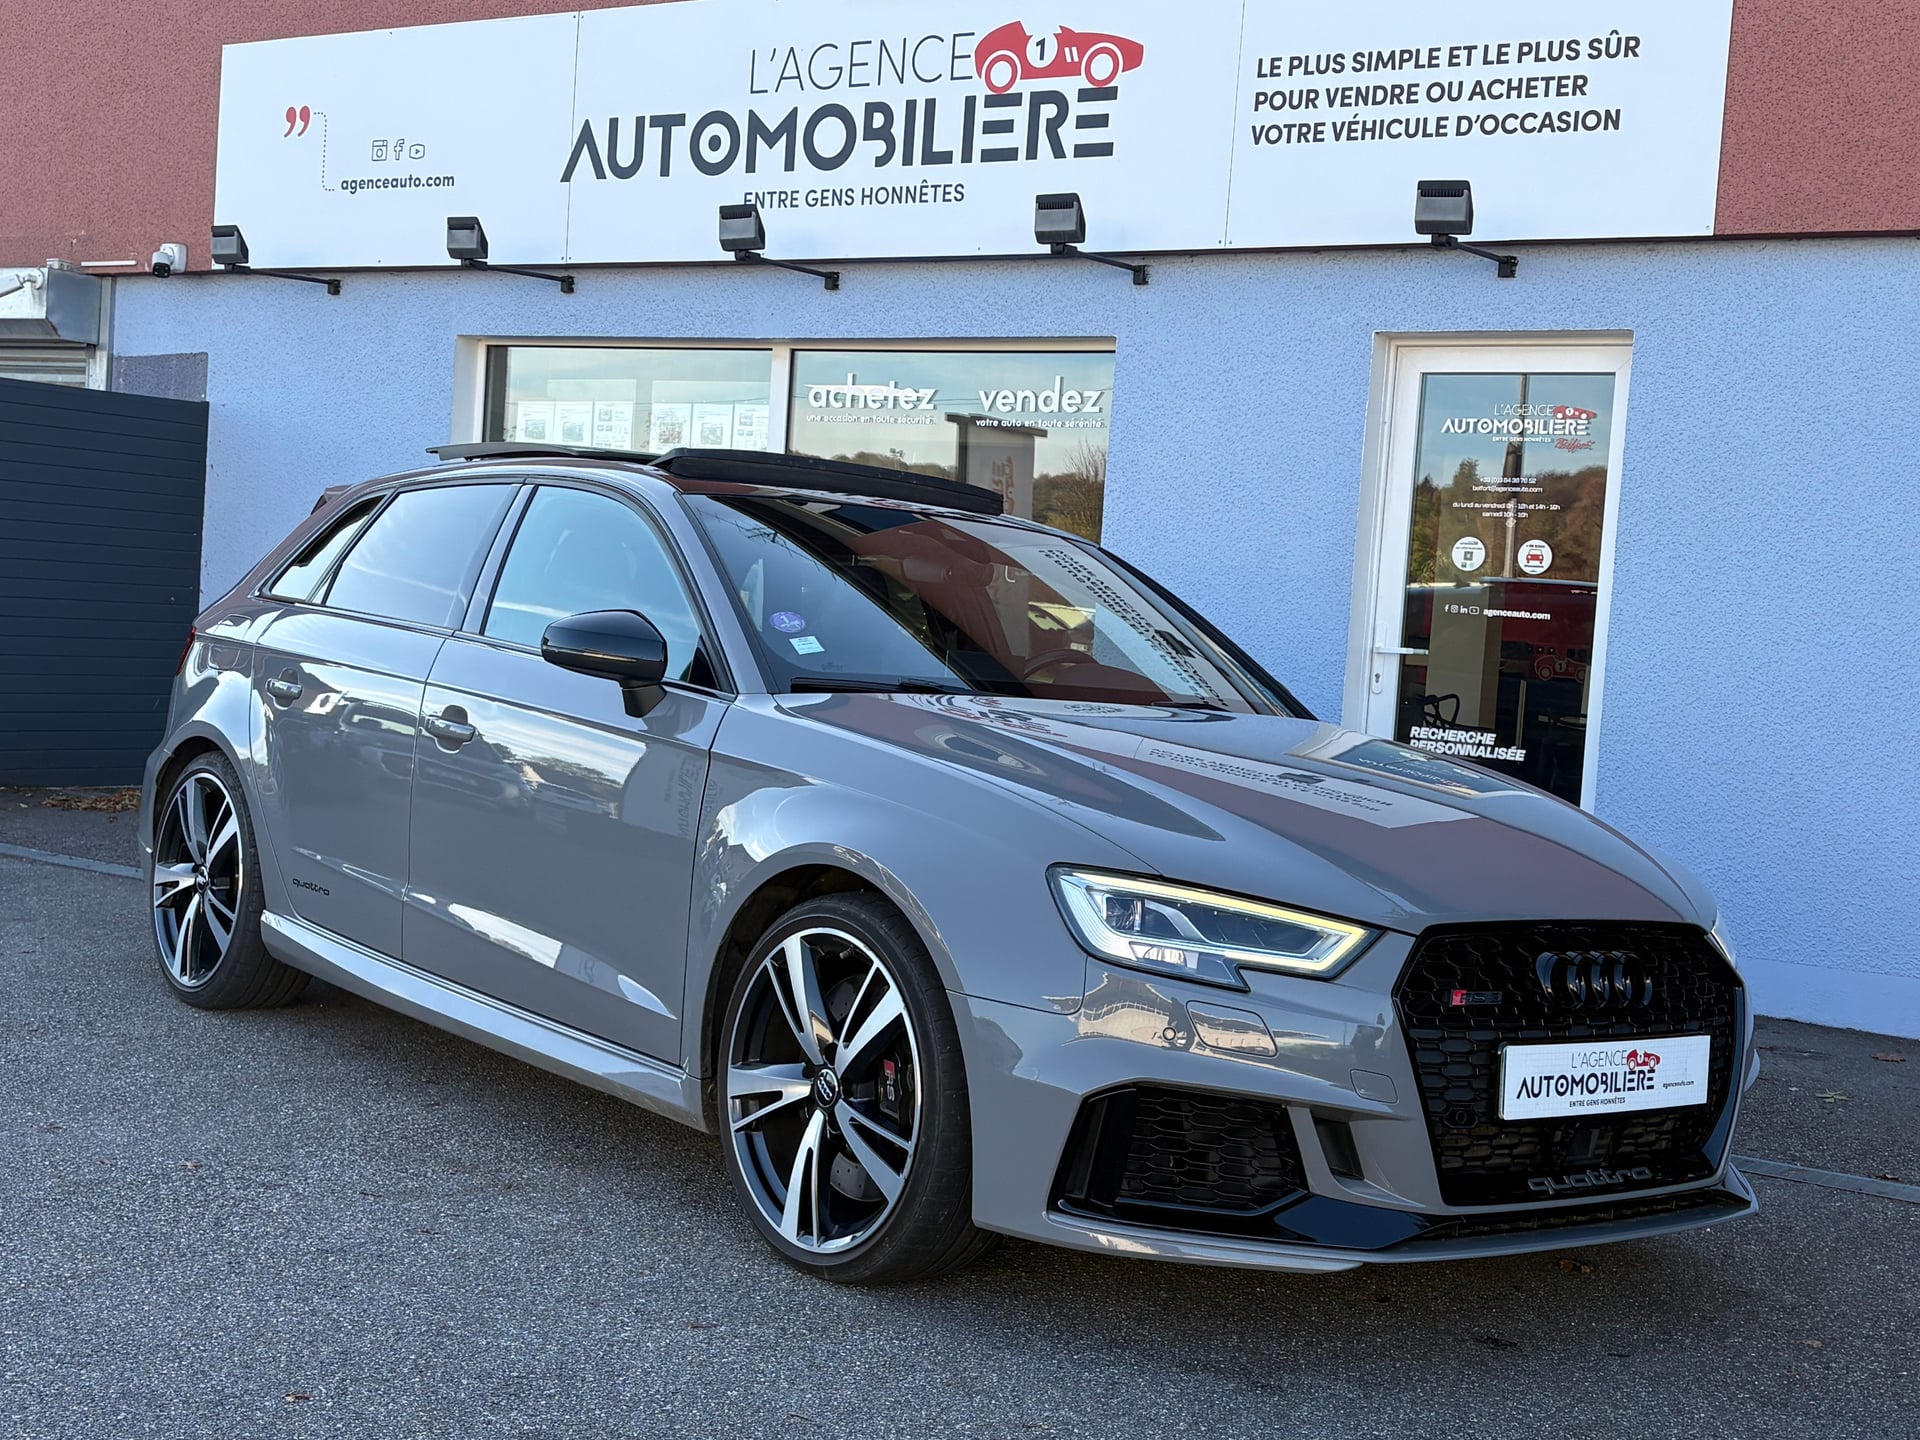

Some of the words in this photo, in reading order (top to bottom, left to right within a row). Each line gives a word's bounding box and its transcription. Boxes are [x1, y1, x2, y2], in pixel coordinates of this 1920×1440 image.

[1035, 37, 1046, 61] 1
[1257, 57, 1284, 79] LE
[1288, 53, 1346, 77] PLUS
[1352, 46, 1441, 73] SIMPLE
[1447, 45, 1478, 68] ET
[1483, 43, 1511, 66] LE
[1519, 39, 1581, 64] PLUS
[1587, 30, 1641, 60] SÛR
[749, 32, 976, 95] L'AGENCE
[1253, 88, 1319, 112] POUR
[1325, 83, 1420, 108] VENDRE
[1425, 81, 1464, 104] OU
[1467, 75, 1589, 102] ACHETER
[1251, 122, 1327, 146] VOTRE
[1331, 113, 1450, 142] VÉHICULE
[1455, 109, 1621, 137] D'OCCASION
[340, 174, 455, 195] agenceauto.com
[744, 190, 800, 209] ENTRE
[805, 188, 855, 208] GENS
[860, 178, 965, 206] HONNÊTES
[808, 373, 937, 411] achetez
[978, 375, 1103, 413] vendez
[807, 414, 822, 422] une
[824, 414, 859, 423] occasion
[861, 415, 871, 423] en
[873, 415, 895, 423] toute
[1494, 404, 1555, 417] L'AGENCE
[975, 419, 999, 427] votre
[1001, 419, 1022, 427] auto
[1038, 419, 1063, 428] toute
[1483, 608, 1551, 621] agenceauto.com
[1410, 726, 1497, 746] RECHERCHE
[1410, 738, 1527, 762] PERSONNALISÉE
[292, 878, 330, 896] quattro
[1571, 1050, 1628, 1069] L'AGENCE
[1569, 1098, 1586, 1108] ENTRE
[1586, 1098, 1600, 1107] GENS
[1600, 1096, 1626, 1106] HONNÊTES
[1528, 1167, 1652, 1195] quattro
